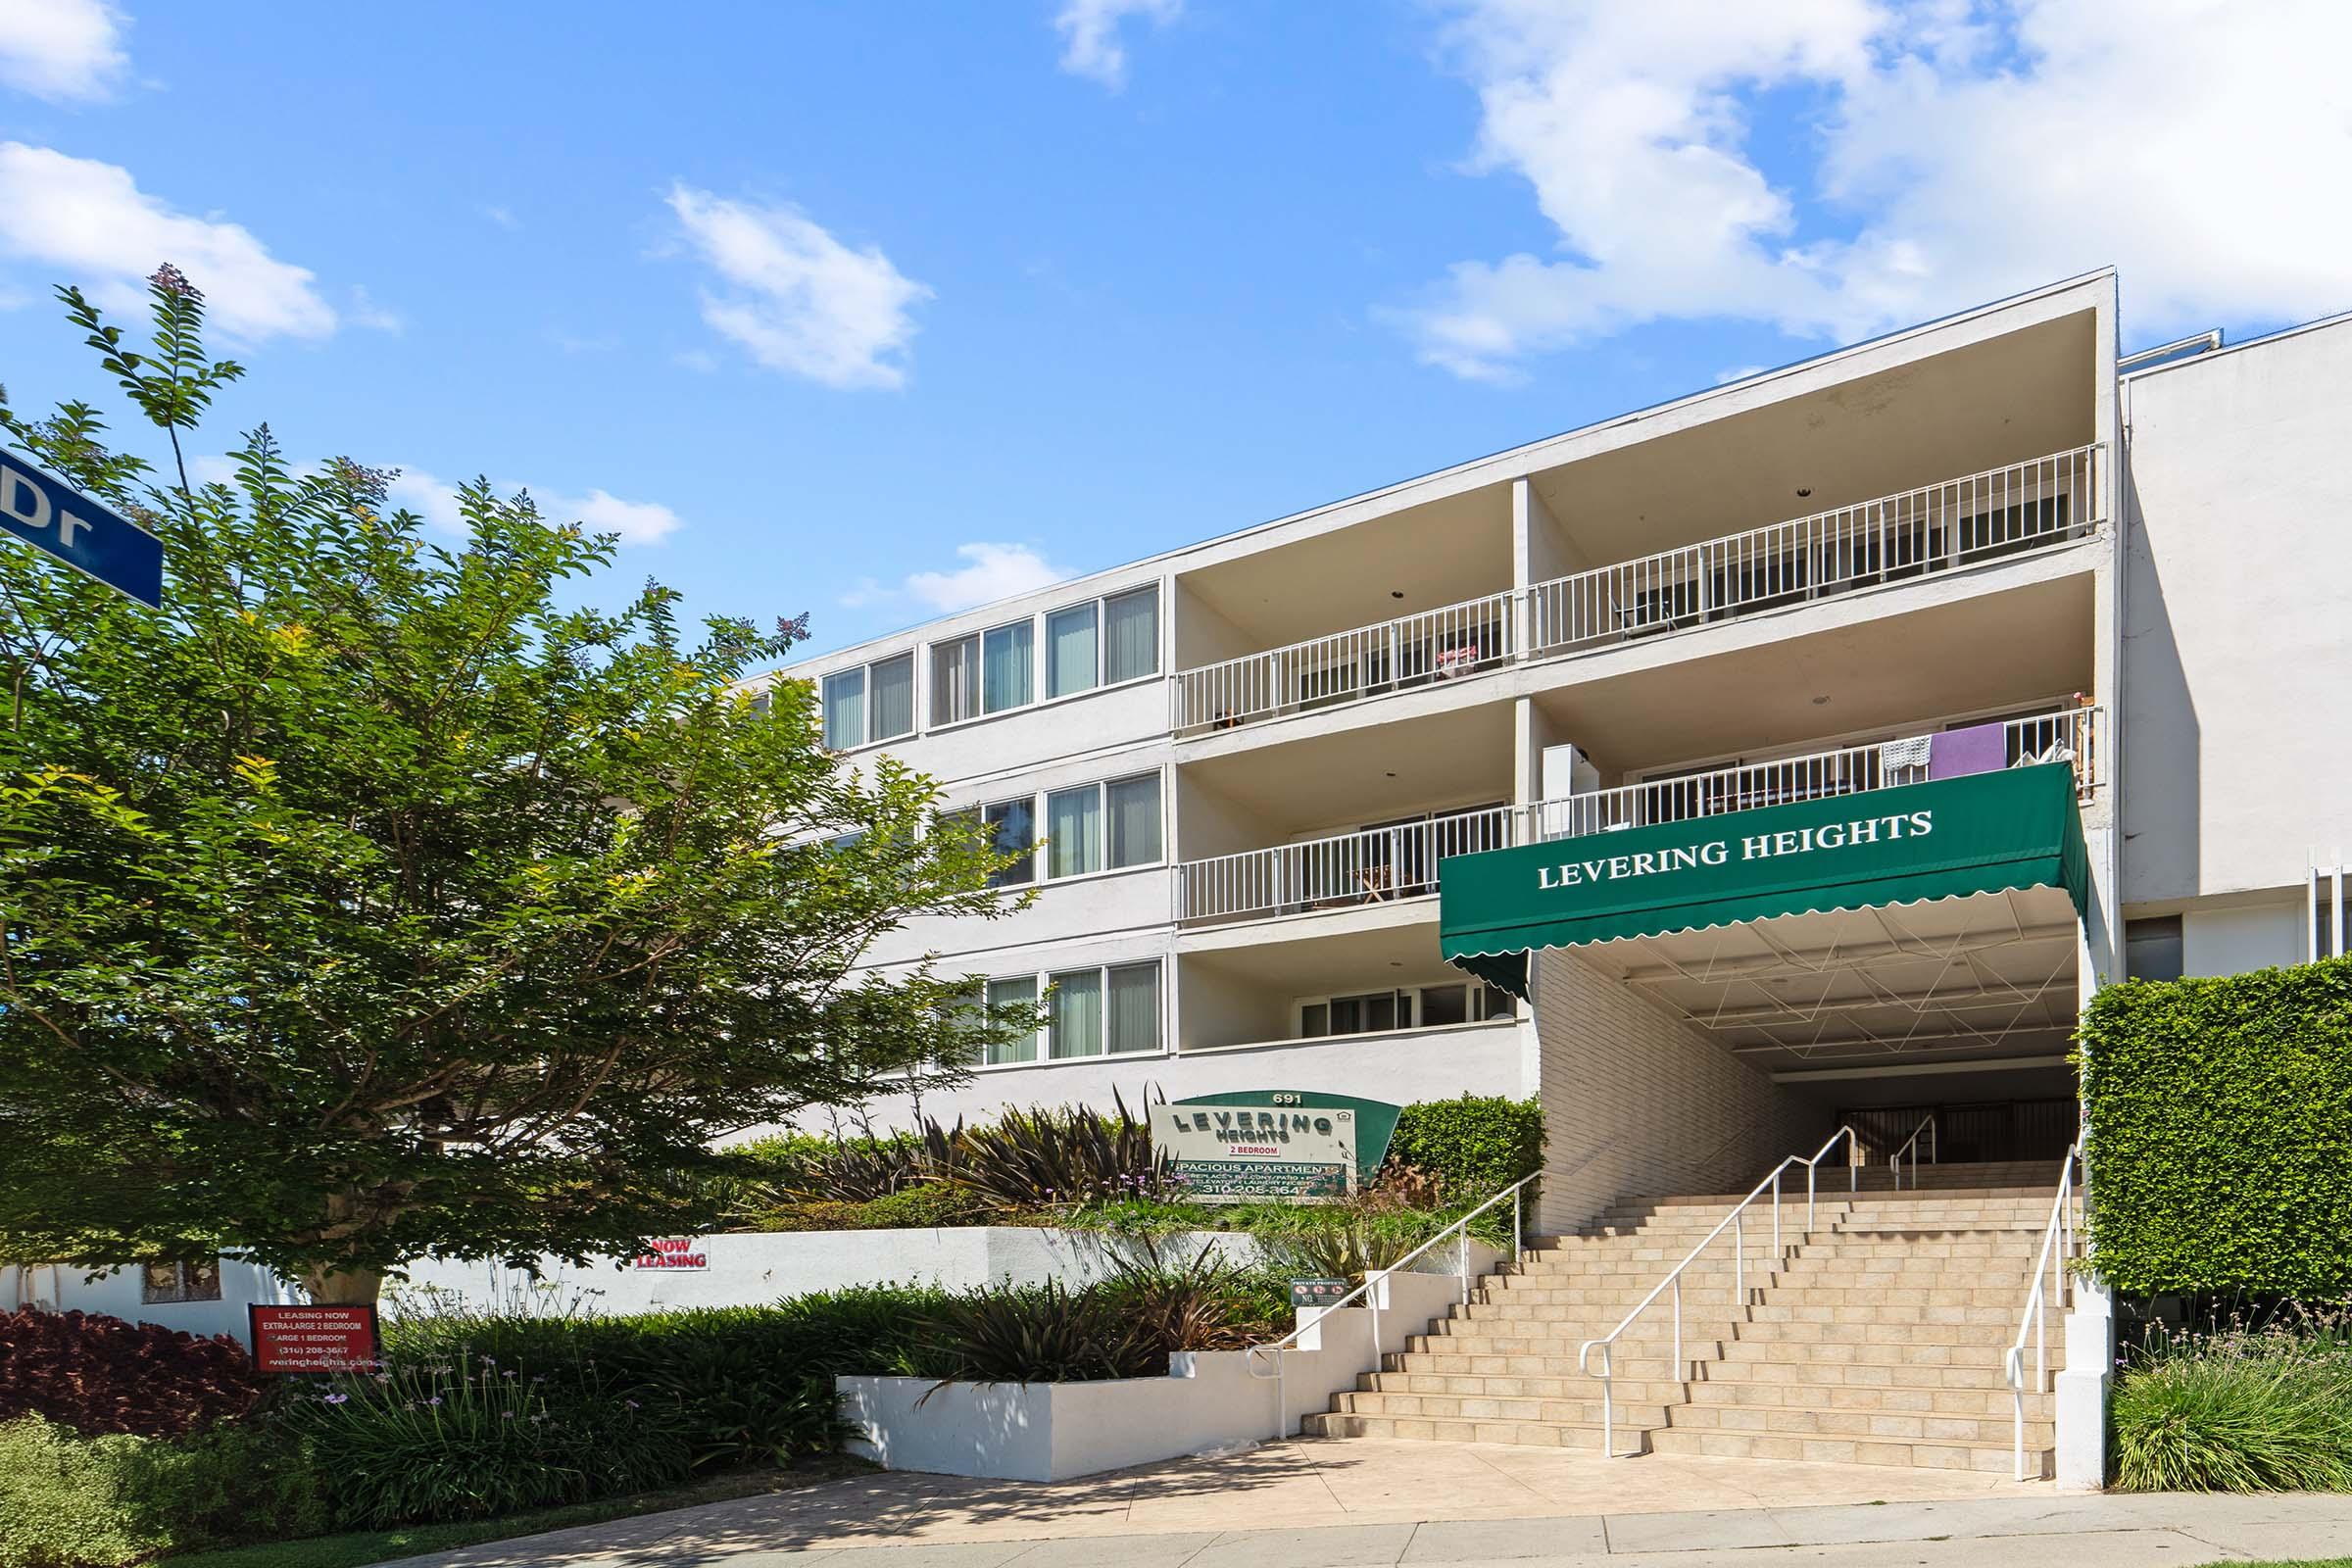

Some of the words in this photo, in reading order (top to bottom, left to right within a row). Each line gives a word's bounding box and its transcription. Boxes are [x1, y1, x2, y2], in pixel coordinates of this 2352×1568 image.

[0, 465, 93, 548] Dr
[1538, 840, 1730, 890] LEVERING
[1740, 809, 1934, 860] HEIGHTS
[1272, 1093, 1302, 1104] 691
[1172, 1110, 1334, 1137] LEVERING
[1215, 1129, 1291, 1144] HEIGHTS
[1237, 1146, 1278, 1154] BEDROOM
[652, 1239, 692, 1252] NOW
[636, 1254, 706, 1268] LEASING
